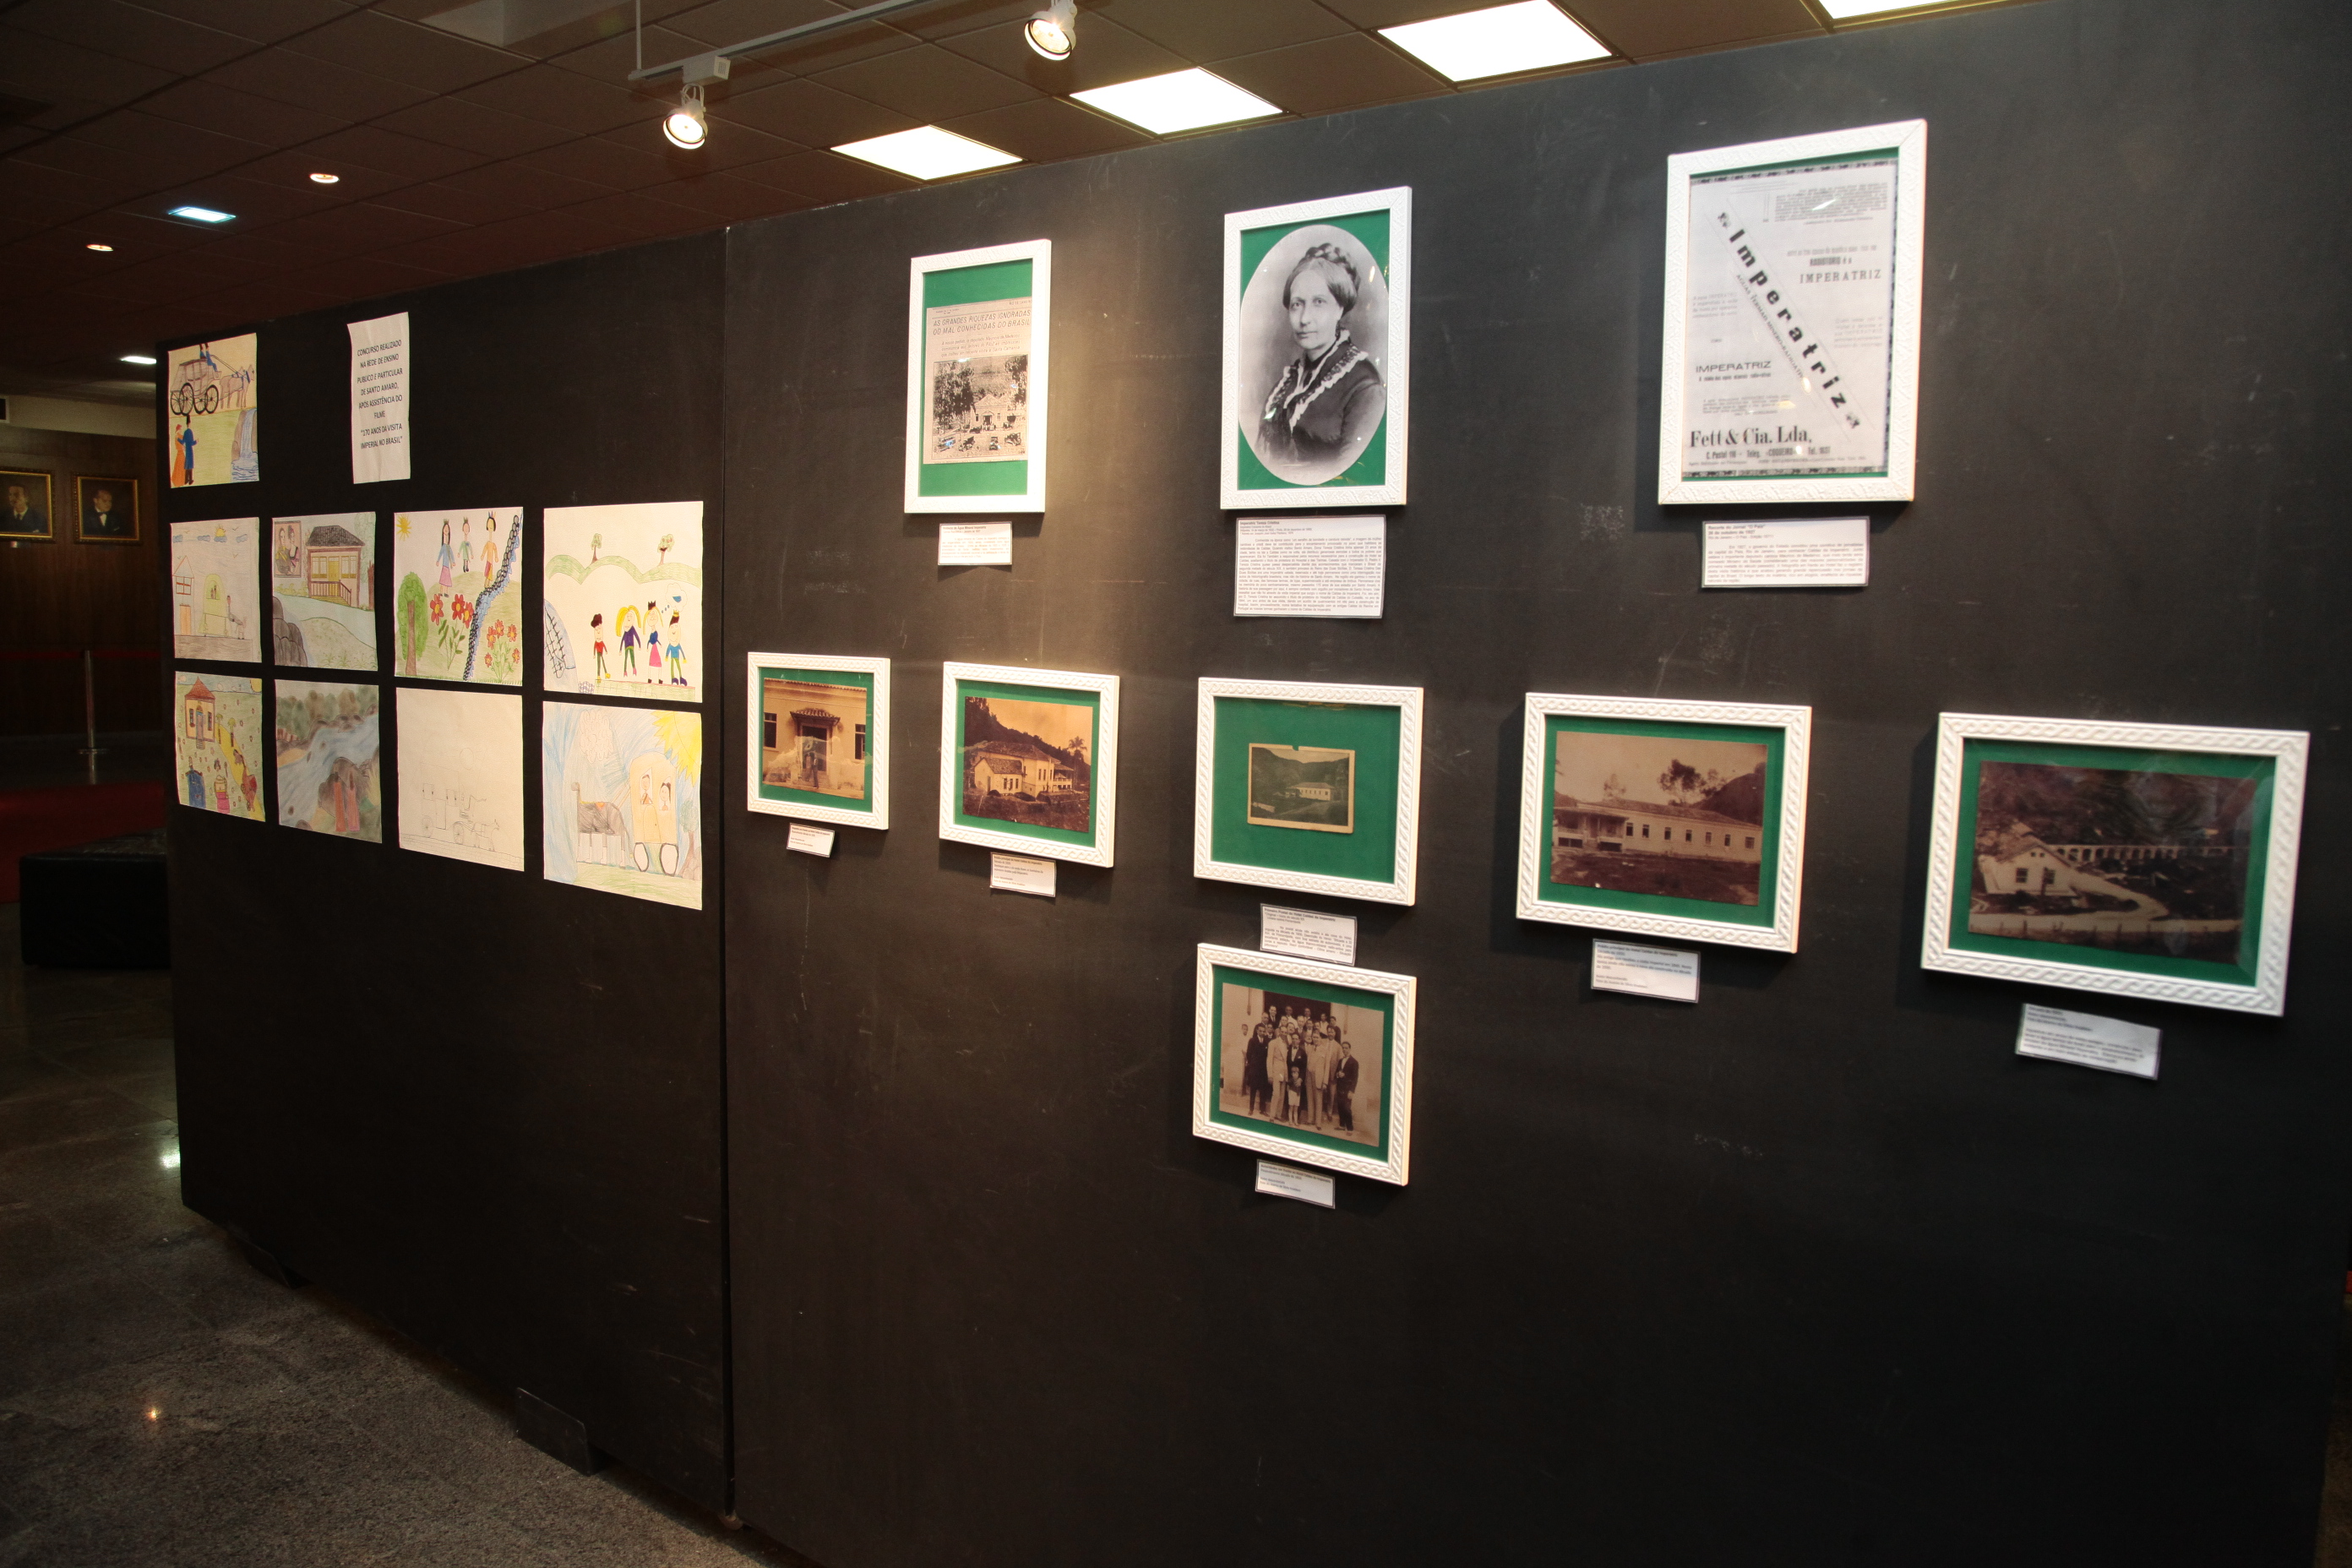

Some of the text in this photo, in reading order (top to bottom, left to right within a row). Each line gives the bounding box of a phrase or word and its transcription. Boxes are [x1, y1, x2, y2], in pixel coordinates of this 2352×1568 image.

[1799, 269, 1881, 284] IMPERATRIZ
[942, 316, 967, 326] GRANDES
[968, 313, 996, 323] RIQUEZAS
[997, 309, 1031, 319] IGNORADAS
[1729, 229, 1846, 408] Imperatriz
[957, 322, 995, 333] CONHECIDAS
[1008, 318, 1031, 328] BRASIL
[357, 340, 402, 357] CONCURSO REALIZADO
[367, 359, 377, 368] REDE
[384, 353, 399, 363] ENSINO
[1696, 361, 1772, 373] IMPERATRIZ
[378, 368, 403, 379] PARTICULAR
[367, 385, 380, 395] SANTO
[381, 382, 399, 392] AMARO,
[369, 395, 395, 406] ASSISTÊNCIA
[374, 411, 385, 419] FILME
[371, 426, 381, 435] ANOS
[388, 423, 402, 432] VISITA
[361, 440, 378, 449] IMPERIAL
[1690, 429, 1721, 448] Fett
[1725, 428, 1740, 445] &
[1743, 427, 1772, 444] Cia.
